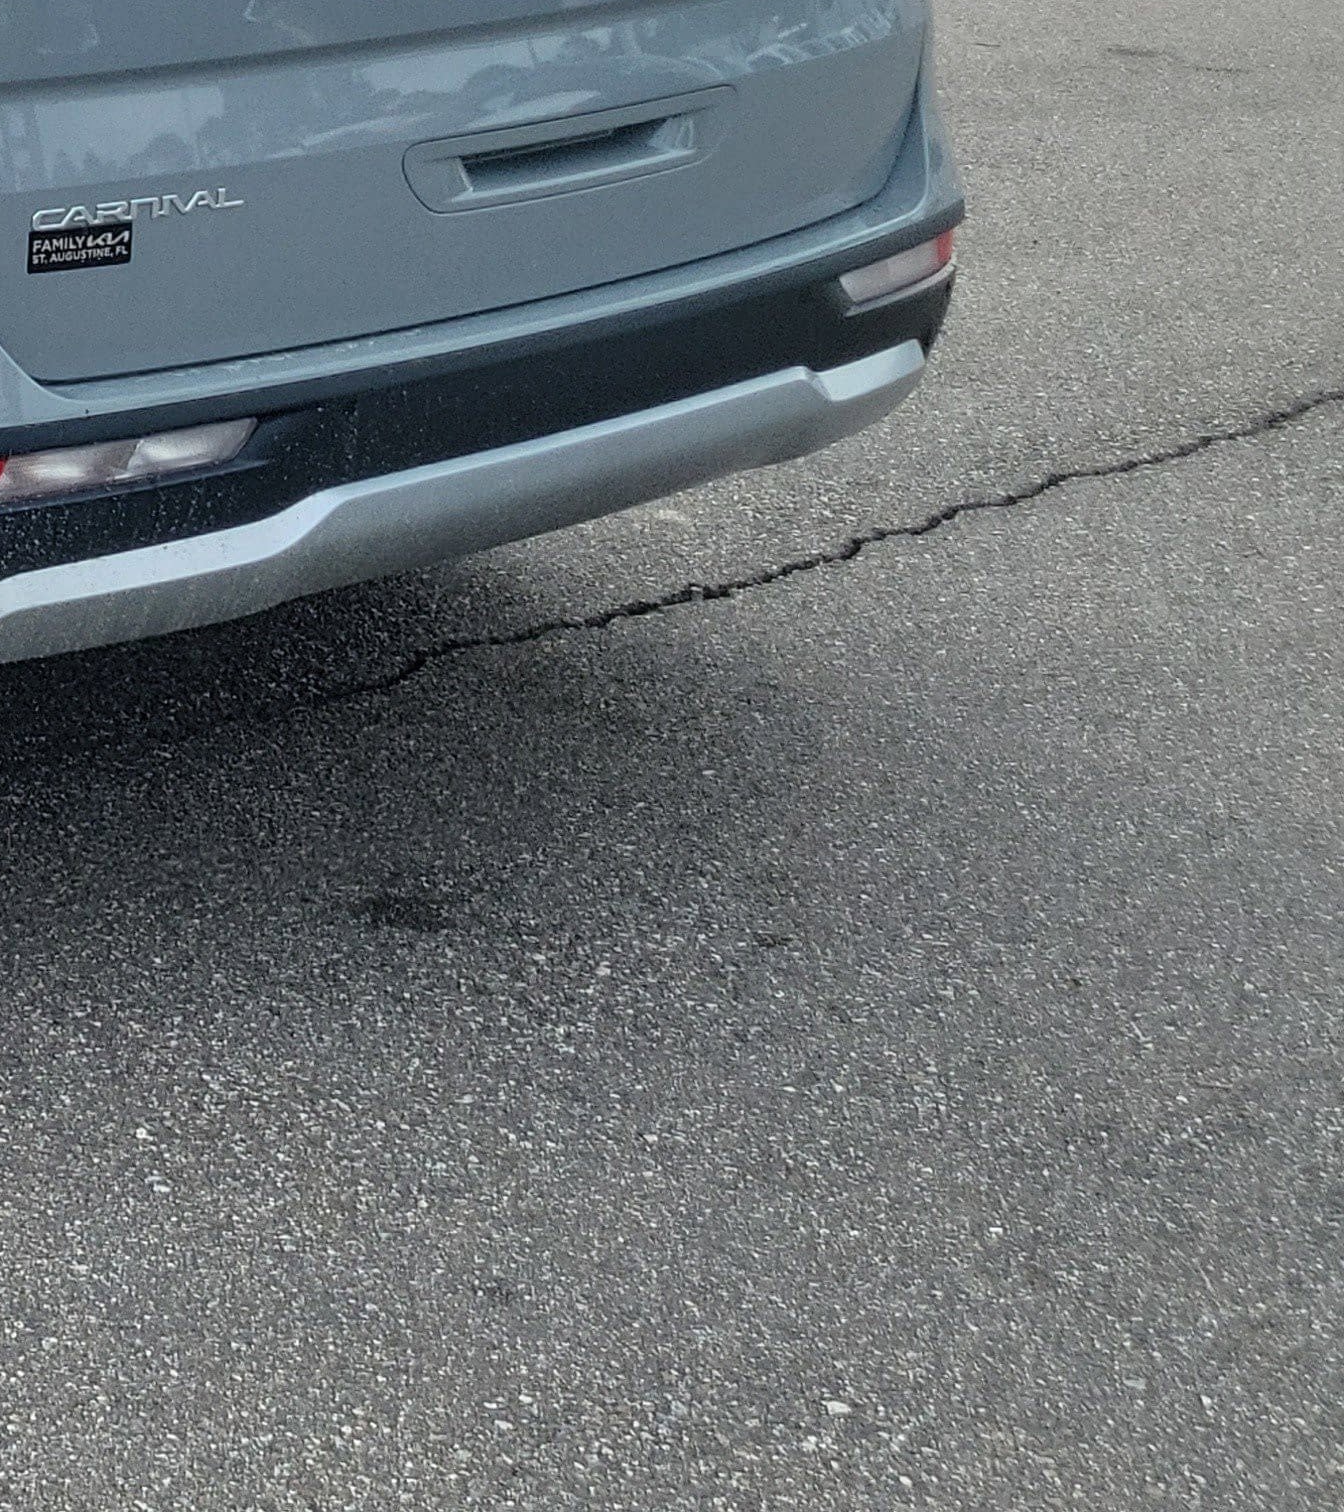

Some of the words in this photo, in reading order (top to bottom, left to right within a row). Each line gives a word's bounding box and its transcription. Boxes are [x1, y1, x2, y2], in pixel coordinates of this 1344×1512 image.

[32, 187, 245, 231] CARNIVAL
[33, 235, 87, 253] FAMILY
[86, 230, 130, 247] KIA
[32, 253, 48, 264] ST.
[49, 247, 114, 263] AUGUSTINE,
[115, 245, 129, 256] FL
